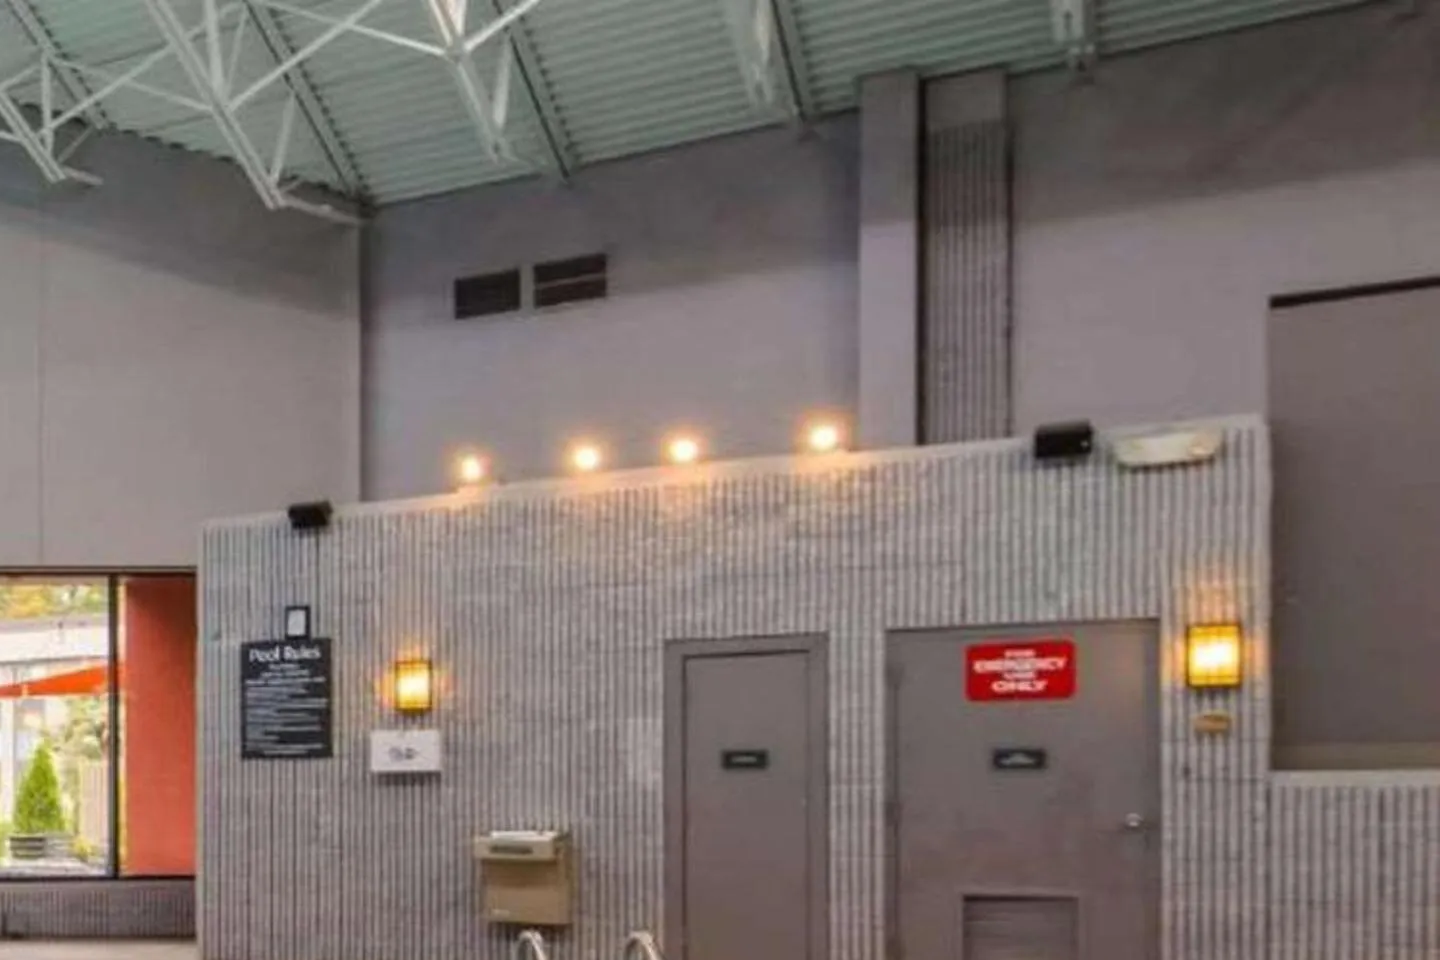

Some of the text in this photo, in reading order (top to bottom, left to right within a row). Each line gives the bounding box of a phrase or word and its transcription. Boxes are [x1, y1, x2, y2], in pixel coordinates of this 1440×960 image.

[249, 644, 322, 662] Pool Rules
[990, 680, 1048, 693] ONLY
